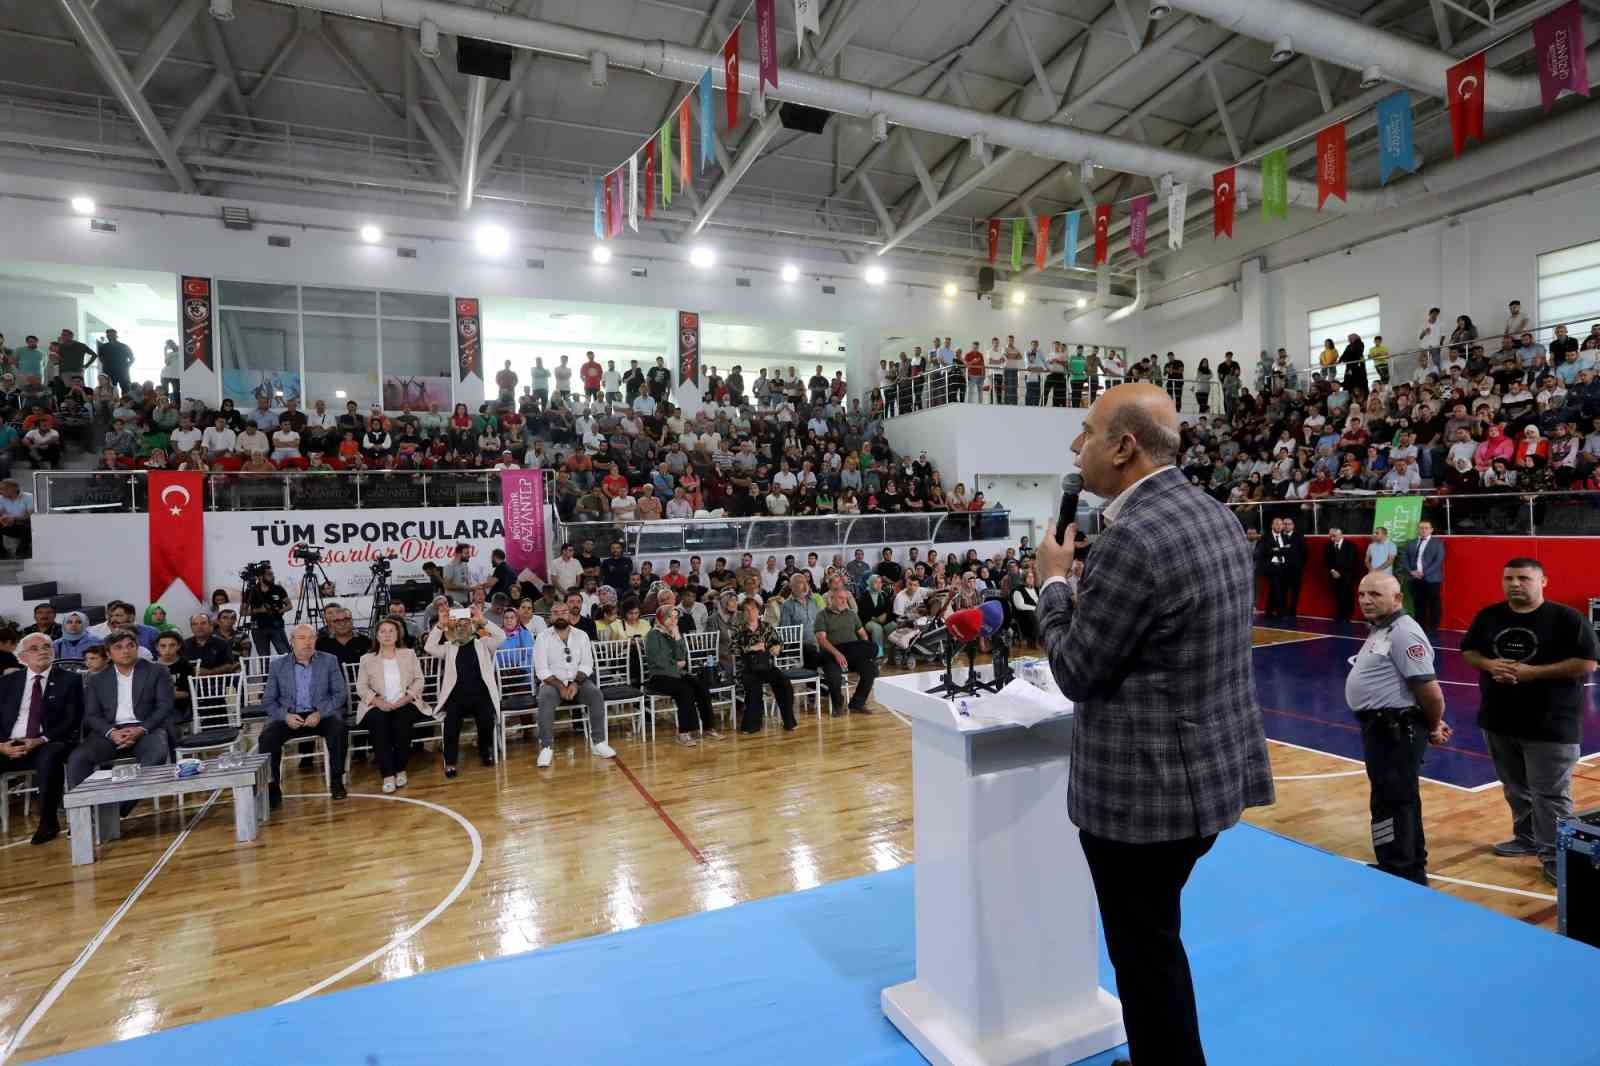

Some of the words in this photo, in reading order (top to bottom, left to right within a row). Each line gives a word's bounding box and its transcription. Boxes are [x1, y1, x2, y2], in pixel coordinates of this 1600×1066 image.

[251, 520, 315, 547] TÜM
[324, 518, 506, 544] SPORCULARA
[288, 543, 396, 567] şarılar
[400, 538, 479, 562] Diler
